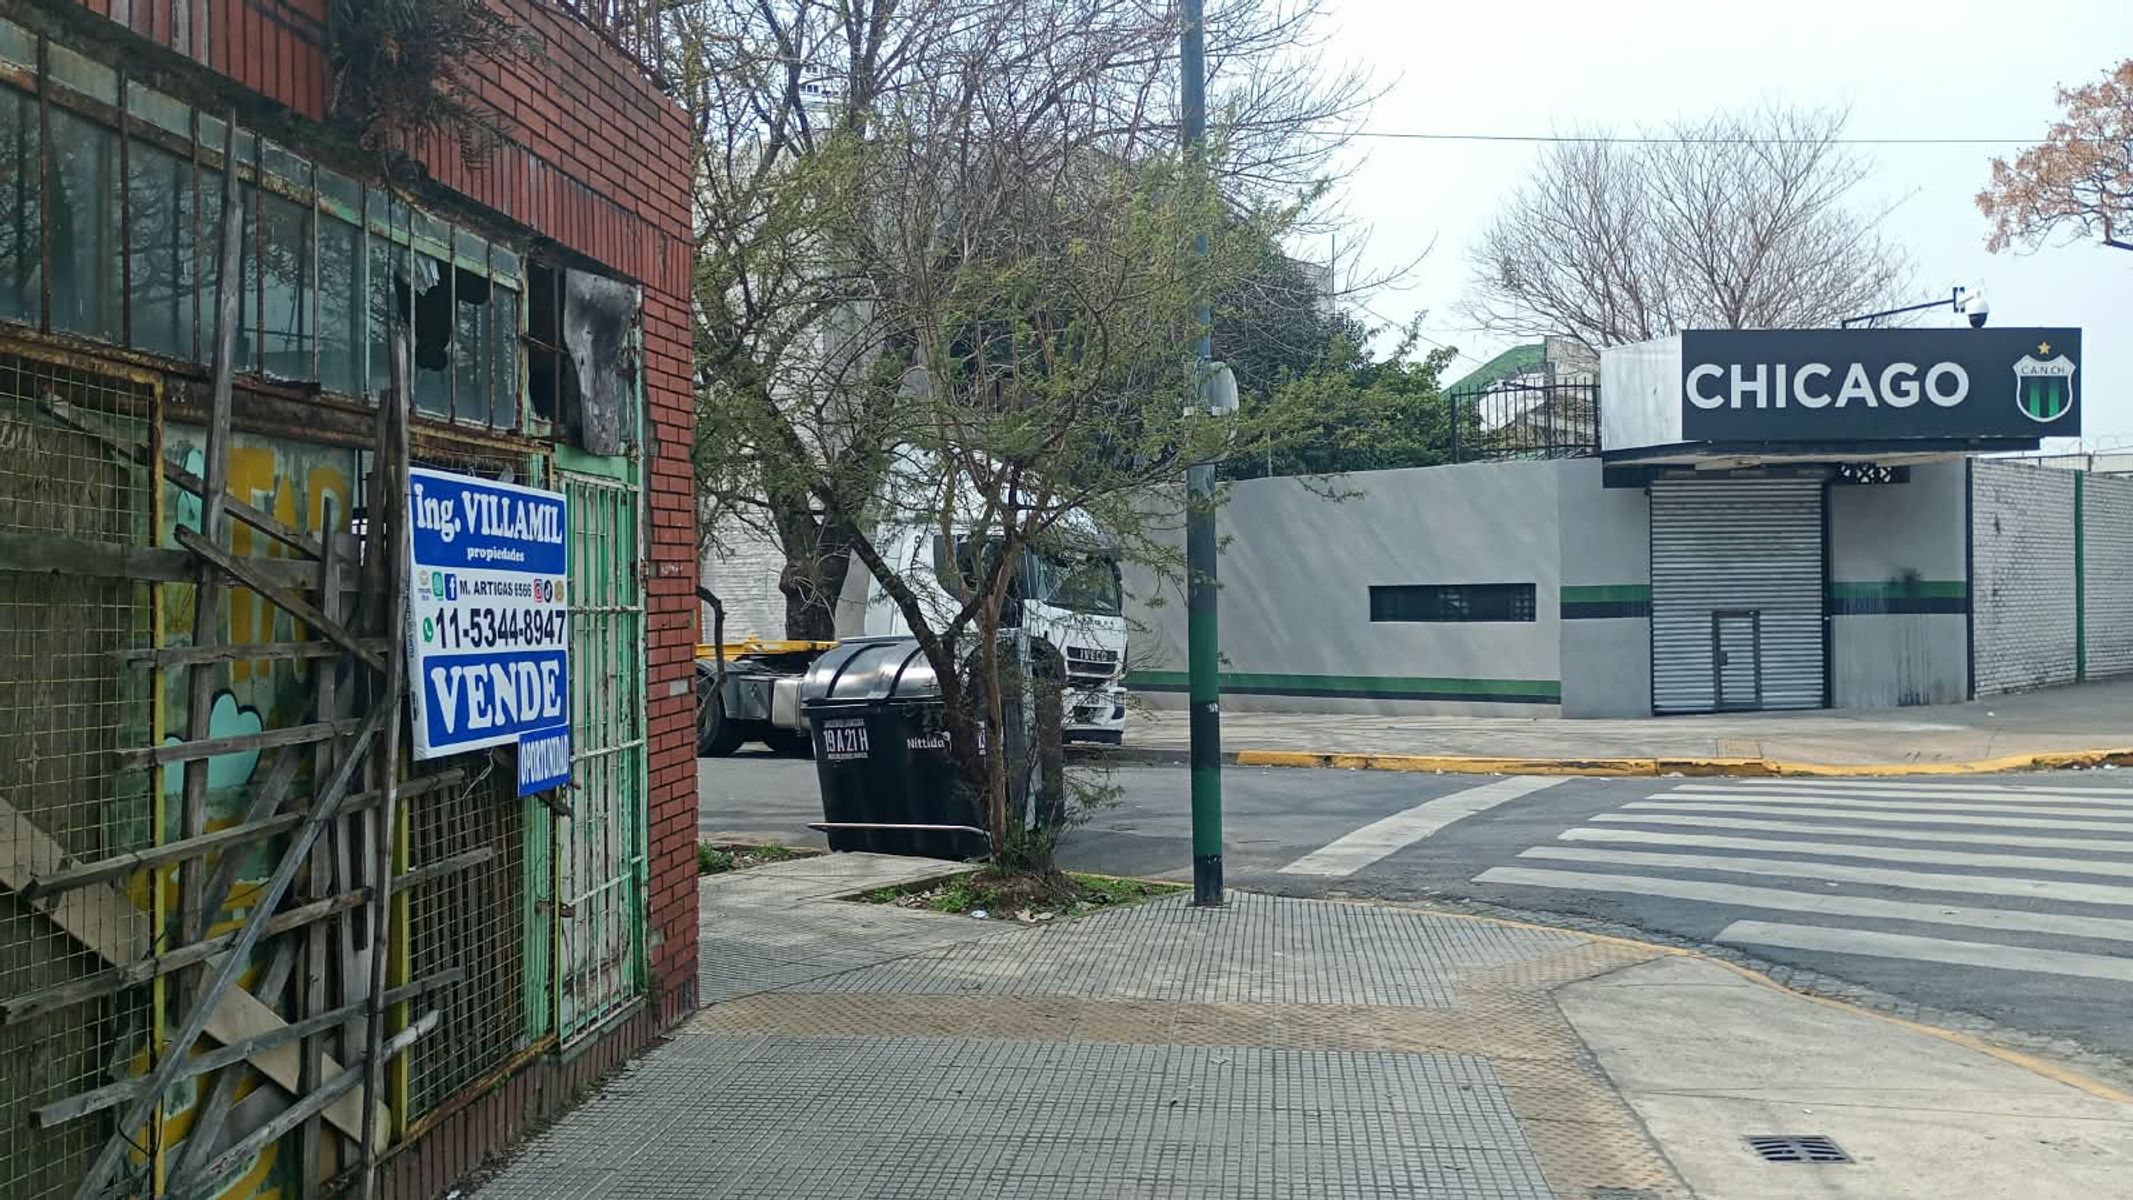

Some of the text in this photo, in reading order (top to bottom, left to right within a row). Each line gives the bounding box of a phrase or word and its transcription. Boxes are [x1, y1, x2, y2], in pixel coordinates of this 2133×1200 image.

[1686, 361, 1970, 409] CHICAGO
[414, 483, 563, 544] Ing. VILLAMIL
[467, 545, 525, 562] propiedades
[459, 580, 471, 596] M.
[474, 581, 513, 597] ARTIGAS
[436, 607, 566, 649] 11-5344-8947
[1080, 649, 1107, 661] IVECO
[430, 659, 561, 734] VENDE
[521, 735, 569, 786] OPORTUNIDAD
